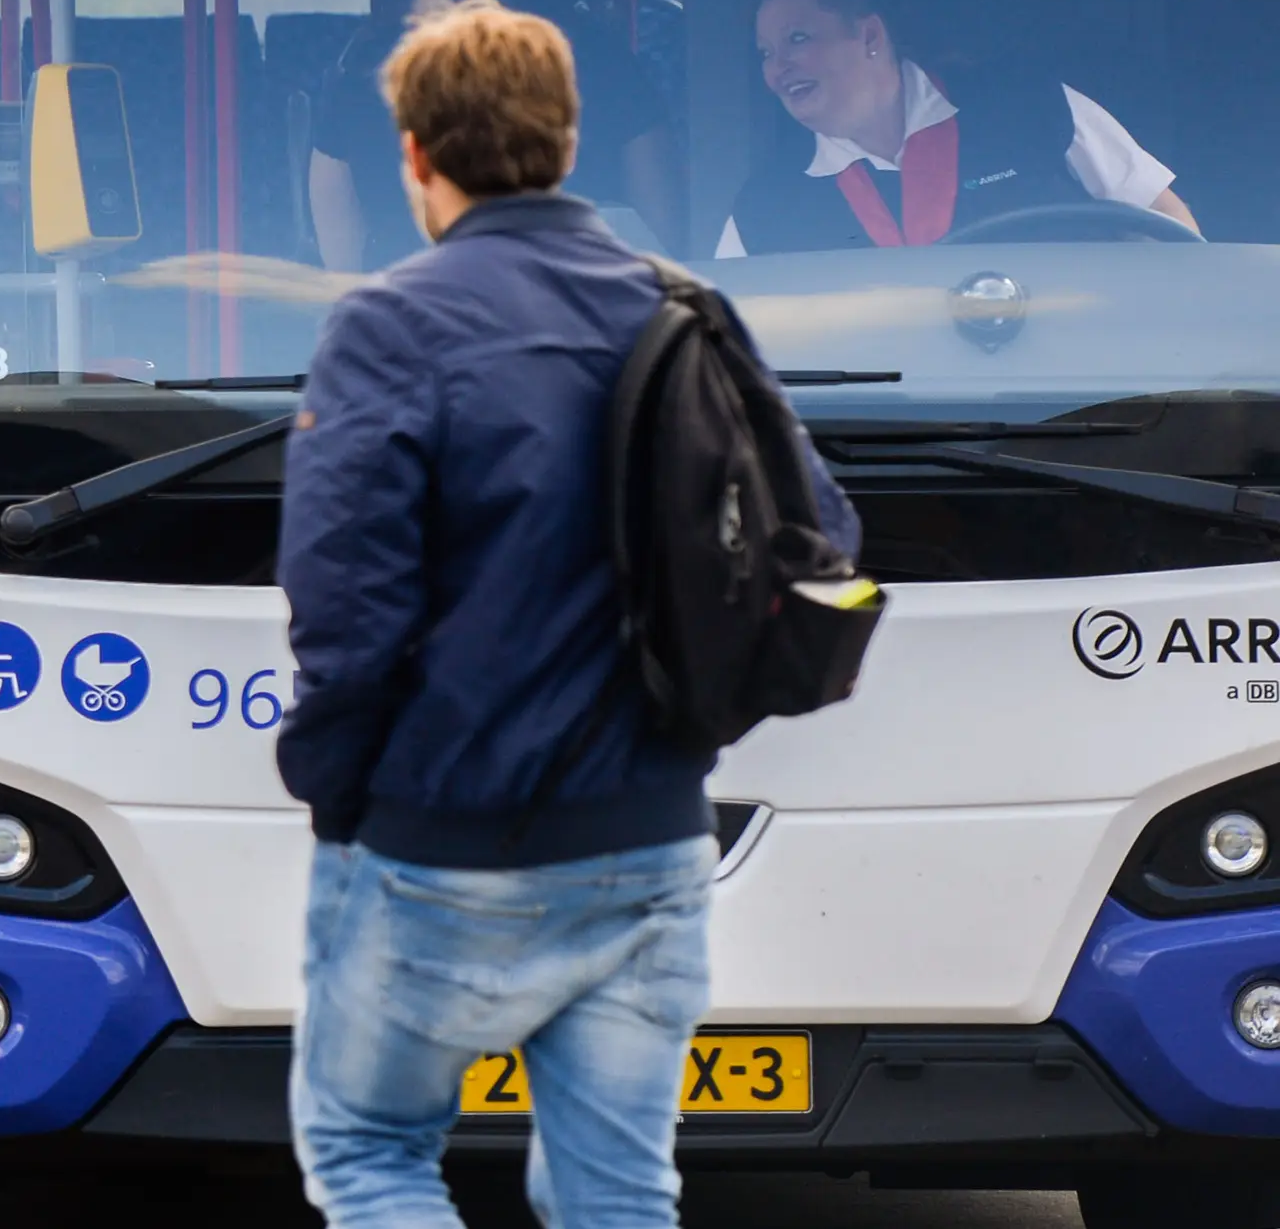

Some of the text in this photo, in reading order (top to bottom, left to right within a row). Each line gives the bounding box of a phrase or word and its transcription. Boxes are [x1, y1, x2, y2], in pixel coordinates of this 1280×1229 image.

[188, 668, 302, 730] 96
[1226, 683, 1276, 700] a DB
